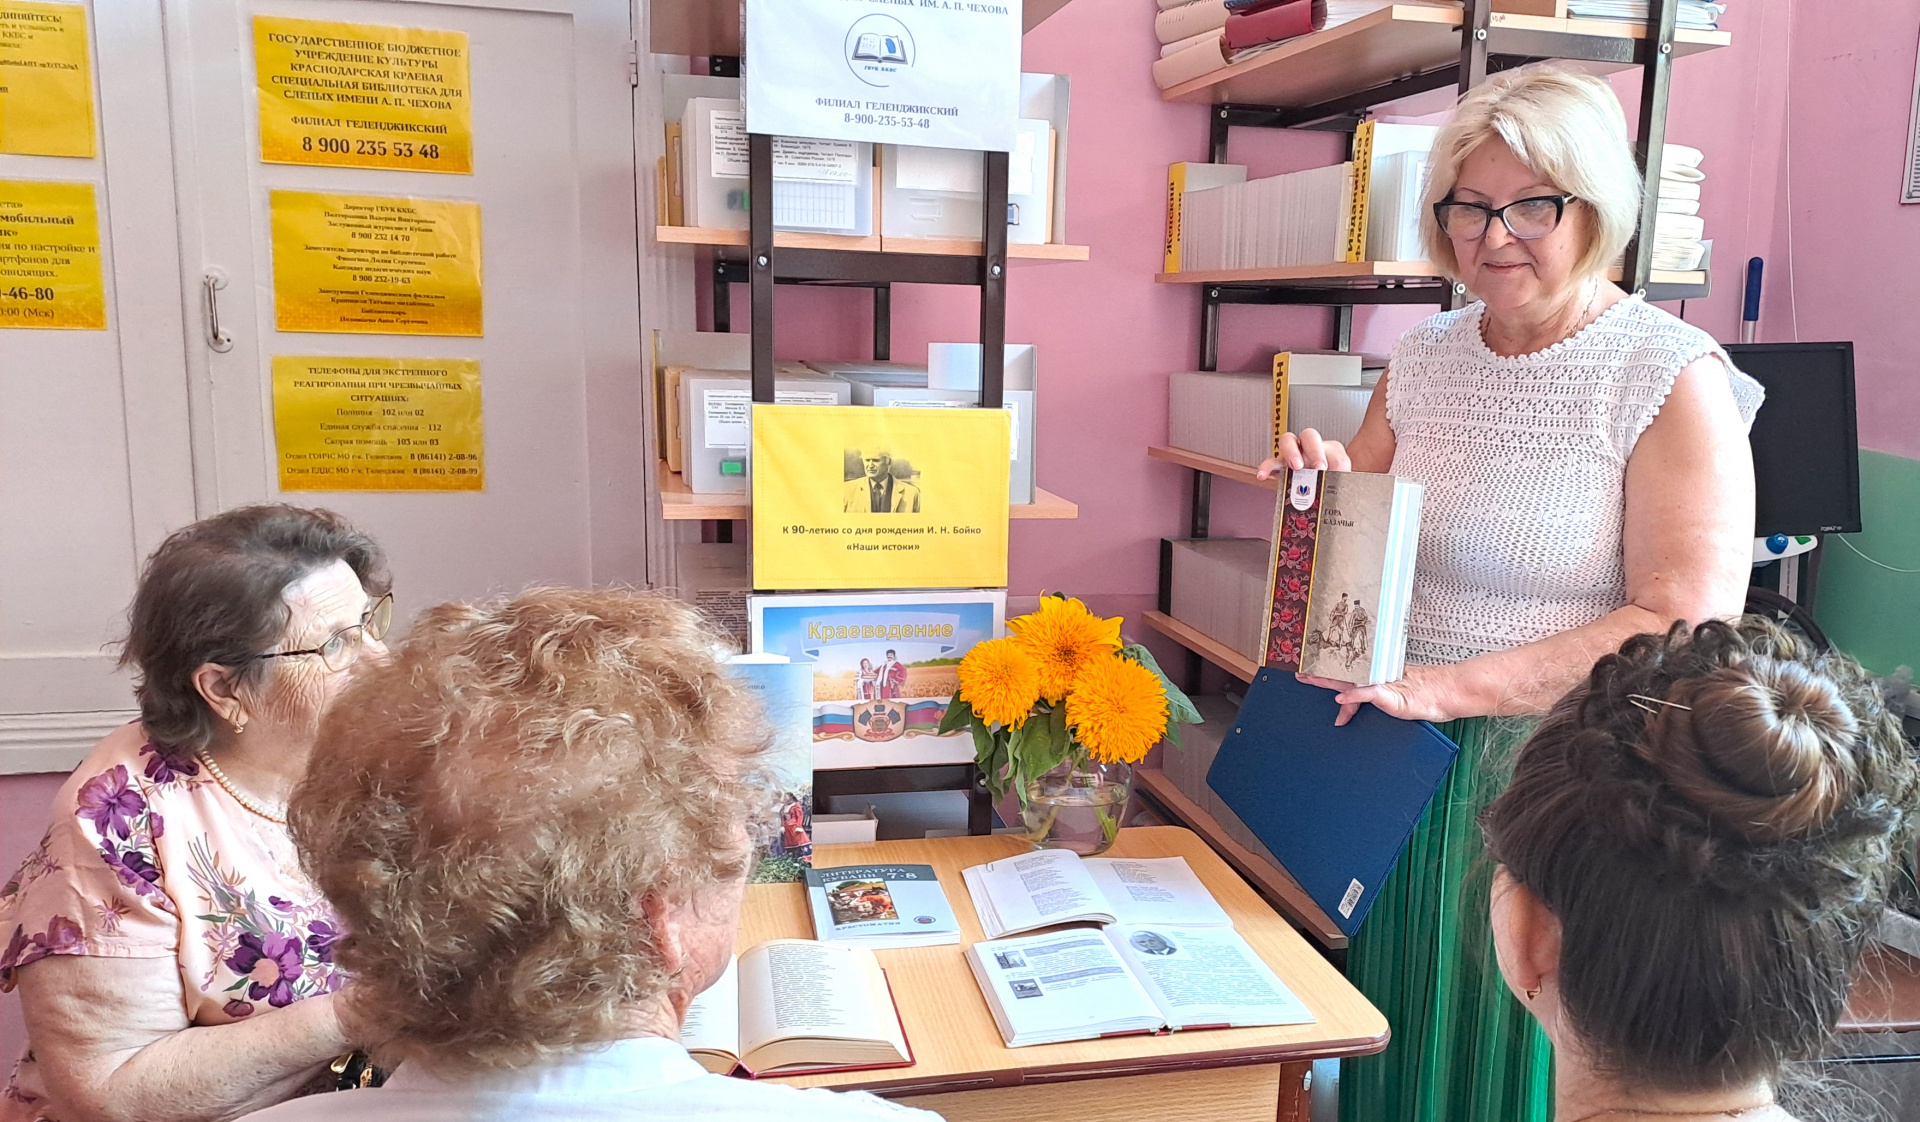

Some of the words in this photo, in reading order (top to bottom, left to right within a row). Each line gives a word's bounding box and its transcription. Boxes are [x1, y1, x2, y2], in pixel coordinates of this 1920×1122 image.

[920, 0, 940, 8] ИМ.
[942, 2, 951, 10] А.
[954, 2, 964, 11] П.
[967, 3, 1009, 15] ЧЕХОВА
[268, 32, 385, 51] ГОСУДАРСТВЕННОЕ
[388, 43, 462, 58] БЮДЖЕТНОЕ
[295, 50, 374, 64] УЧРЕЖДЕНИЕ
[376, 56, 438, 69] КУЛЬТУРЫ
[290, 63, 390, 79] КРАСНОДАРСКАЯ
[393, 71, 444, 83] КРАЕВАЯ
[271, 75, 359, 91] СПЕЦИАЛЬНАЯ
[362, 82, 437, 96] БИБЛИОТЕКА
[440, 88, 463, 98] ДЛЯ
[284, 90, 334, 102] СЛЕПЫХ
[336, 94, 379, 105] ИМЕНИ
[382, 97, 392, 106] А.
[394, 98, 405, 108] П.
[408, 98, 453, 110] ЧЕХОВА
[815, 97, 862, 110] ФИЛИАЛ
[865, 101, 959, 117] ГЕЛЕНДЖИКСКИЙ
[291, 116, 341, 128] ФИЛИАЛ
[346, 119, 448, 135] ГЕЛЕНДЖИКСКИЙ
[844, 112, 930, 130] 8-900-235-53-48
[302, 136, 313, 152] 8
[318, 137, 350, 154] 900
[356, 140, 388, 156] 235
[393, 142, 413, 158] 53
[418, 143, 440, 160] 48
[1348, 167, 1360, 252] Издания
[1356, 137, 1362, 161] на
[0, 213, 74, 225] мобильный
[351, 231, 357, 239] 8
[358, 232, 372, 240] 900
[374, 232, 388, 241] 232
[390, 234, 399, 242] 14
[400, 234, 410, 242] 70
[14, 243, 28, 251] по
[30, 244, 86, 254] настройке
[0, 254, 49, 266] ртфонов
[358, 274, 373, 282] 900
[374, 275, 412, 284] 232-19-63
[0, 286, 54, 300] -46-80
[24, 308, 55, 319] (Мск)
[308, 367, 361, 376] ТЕЛЕФОНЫ
[362, 368, 381, 376] ДЛЯ
[382, 368, 448, 377] ЭКСТРЕННОГО
[293, 380, 366, 390] РЕАГИРОВАНИЯ
[368, 381, 387, 390] ПРИ
[388, 381, 463, 391] ЧРЕЗВЫЧАЙНЫХ
[350, 394, 410, 403] СИТУАЦИЯХ:
[336, 408, 373, 417] Полиция
[382, 408, 396, 417] 102
[414, 409, 425, 417] 02
[319, 422, 350, 432] Единая
[352, 423, 382, 432] служба
[382, 424, 419, 432] спасения
[428, 424, 442, 432] 112
[324, 438, 354, 446] Скорая
[396, 438, 412, 446] 103
[429, 438, 440, 446] 03
[417, 453, 447, 462] (86141)
[448, 453, 478, 461] 2-08-96
[336, 466, 350, 474] МО
[420, 468, 446, 476] (86141)
[782, 526, 789, 534] К
[791, 524, 839, 536] 90-летию
[842, 527, 853, 535] со
[855, 527, 873, 537] дня
[875, 527, 924, 538] рождения
[926, 526, 938, 535] И.
[940, 526, 950, 535] Н.
[952, 524, 982, 535] Бойко
[846, 542, 880, 551] «Наши
[882, 542, 920, 551] истоки»
[808, 621, 954, 643] Краеведение
[820, 868, 906, 878] ЛИТЕРАТУРА
[822, 873, 877, 882] КУБАНИ
